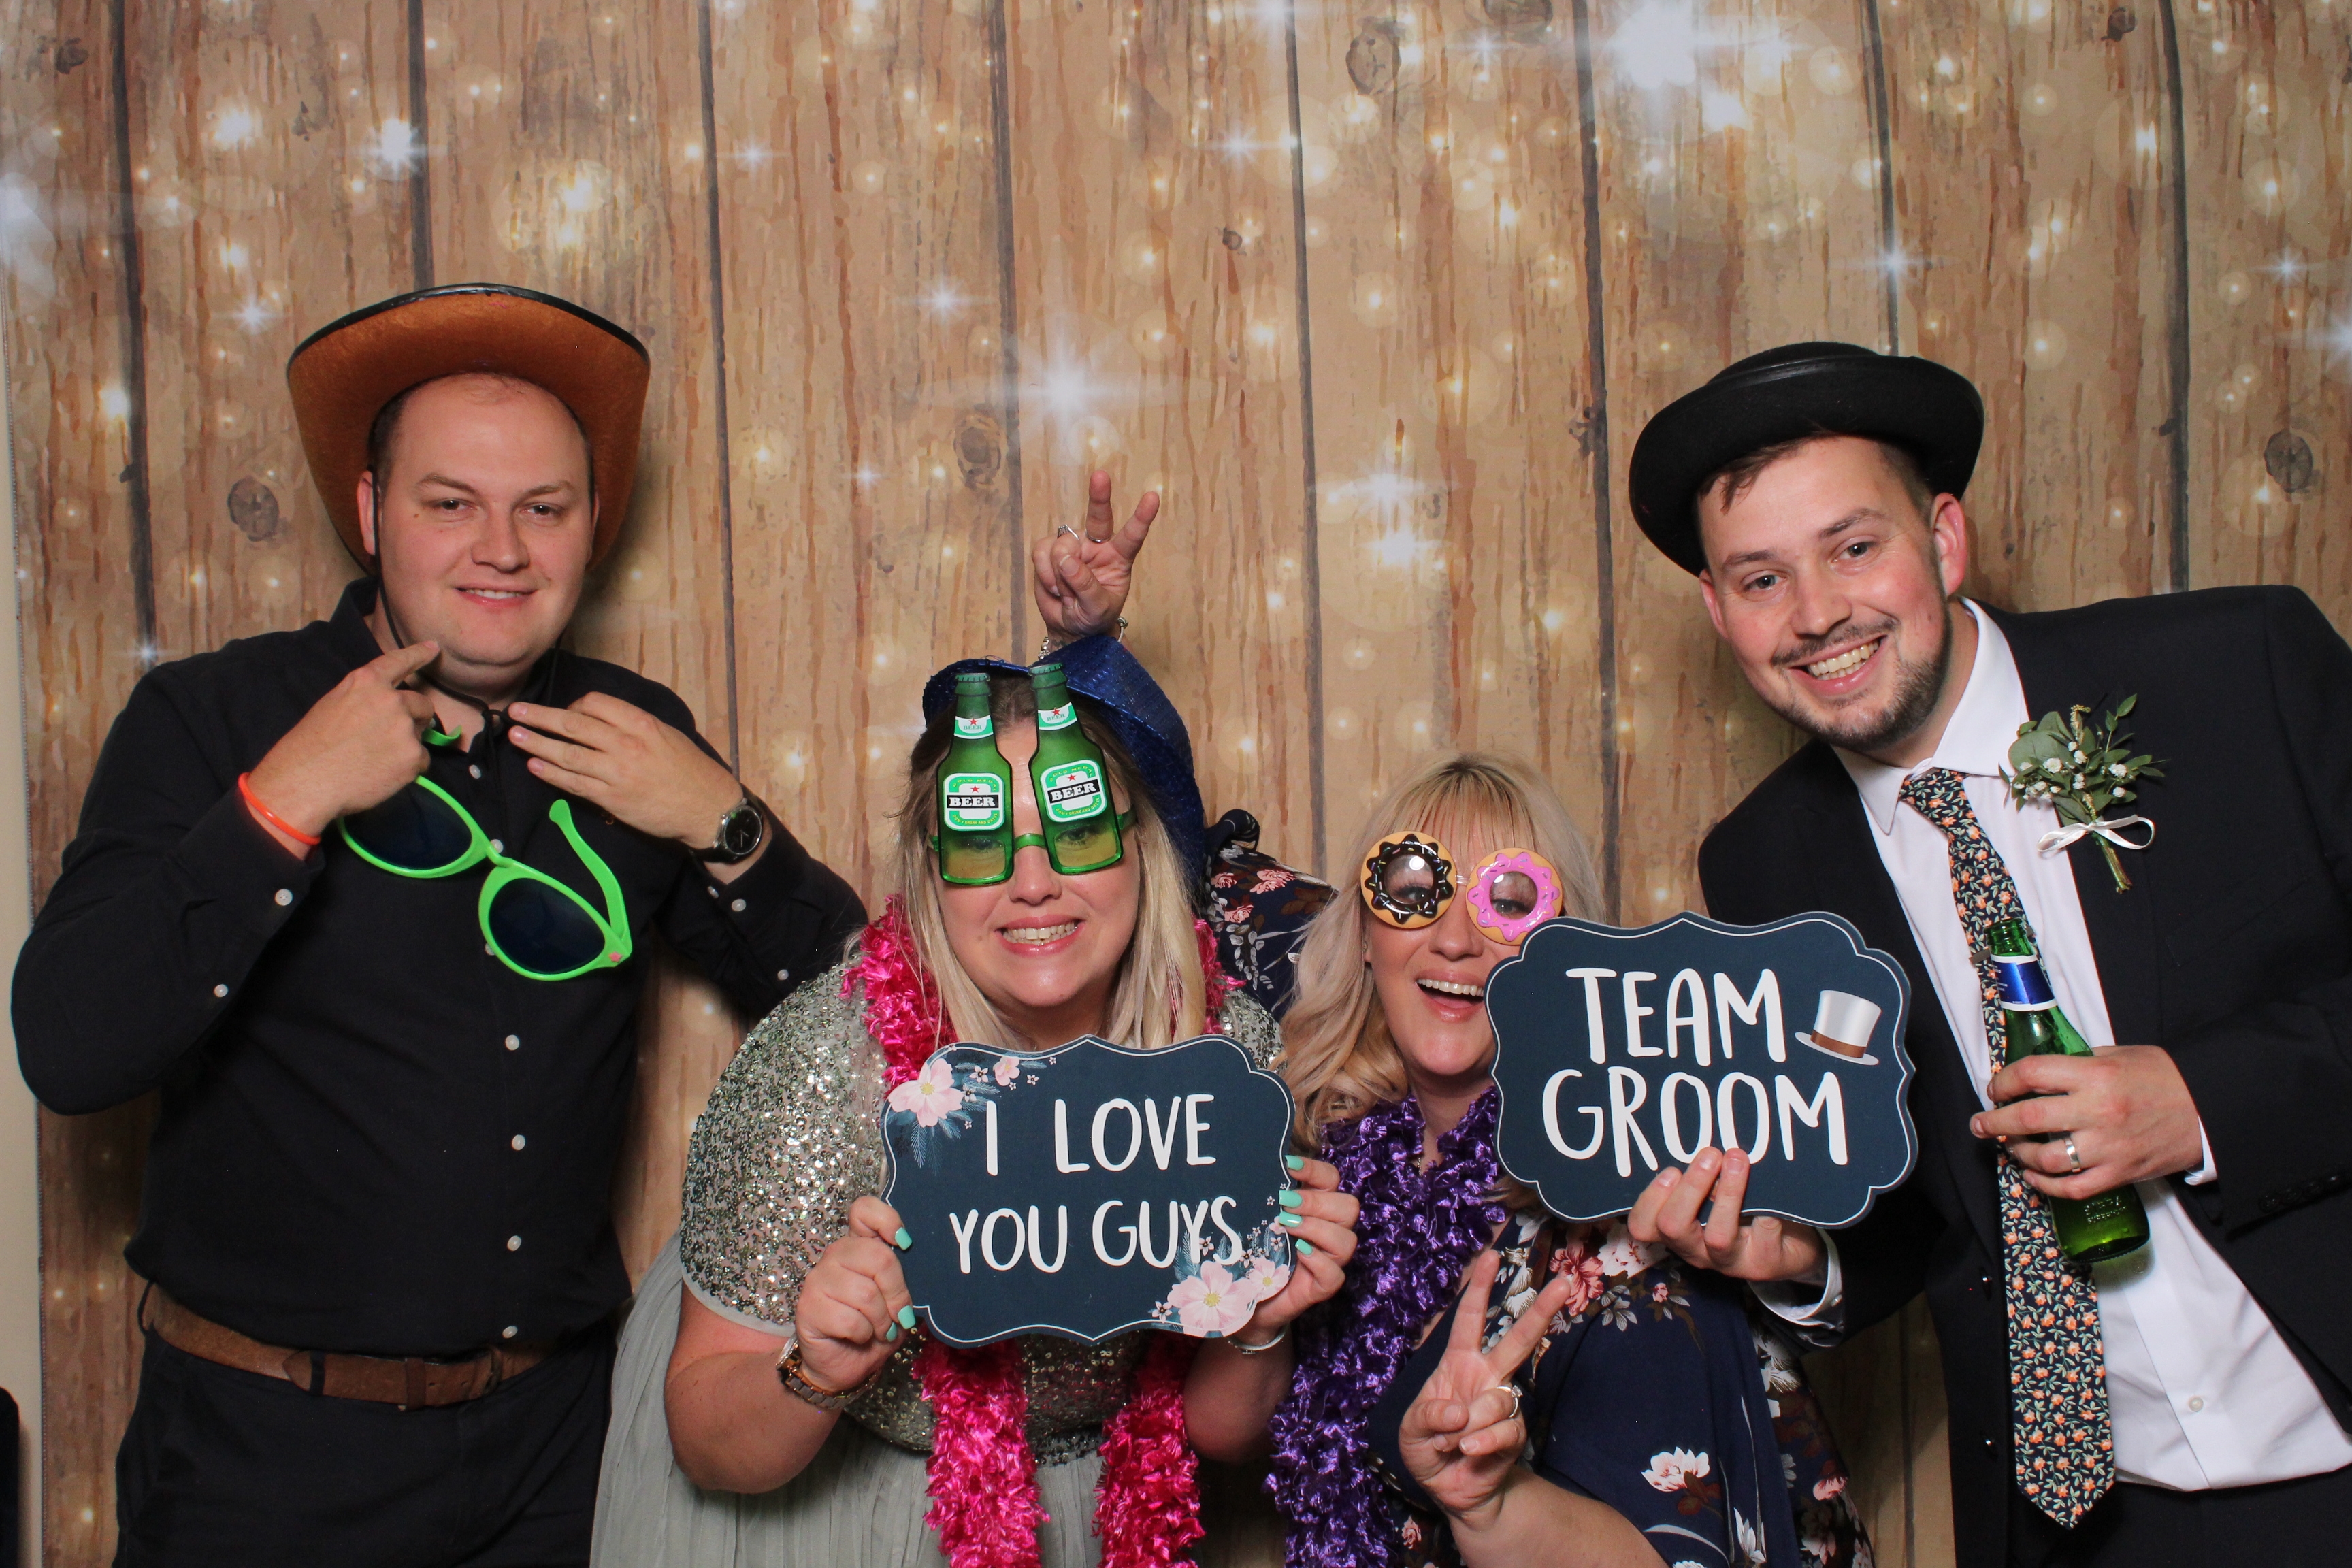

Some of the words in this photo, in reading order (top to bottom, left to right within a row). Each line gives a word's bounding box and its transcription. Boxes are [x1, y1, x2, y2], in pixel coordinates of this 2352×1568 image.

[953, 779, 973, 787] GOLD
[977, 779, 997, 791] MEDAL
[1049, 770, 1068, 782] GOLD
[1071, 766, 1093, 777] MEDAL
[1050, 782, 1097, 802] BEER
[949, 796, 996, 807] BEER
[1565, 968, 1787, 1066] TEAM
[986, 1100, 998, 1176] I
[1054, 1094, 1217, 1174] LOVE
[1541, 1066, 1848, 1178] GROOM
[949, 1205, 1068, 1275] YOU
[1092, 1196, 1244, 1269] GUYS
